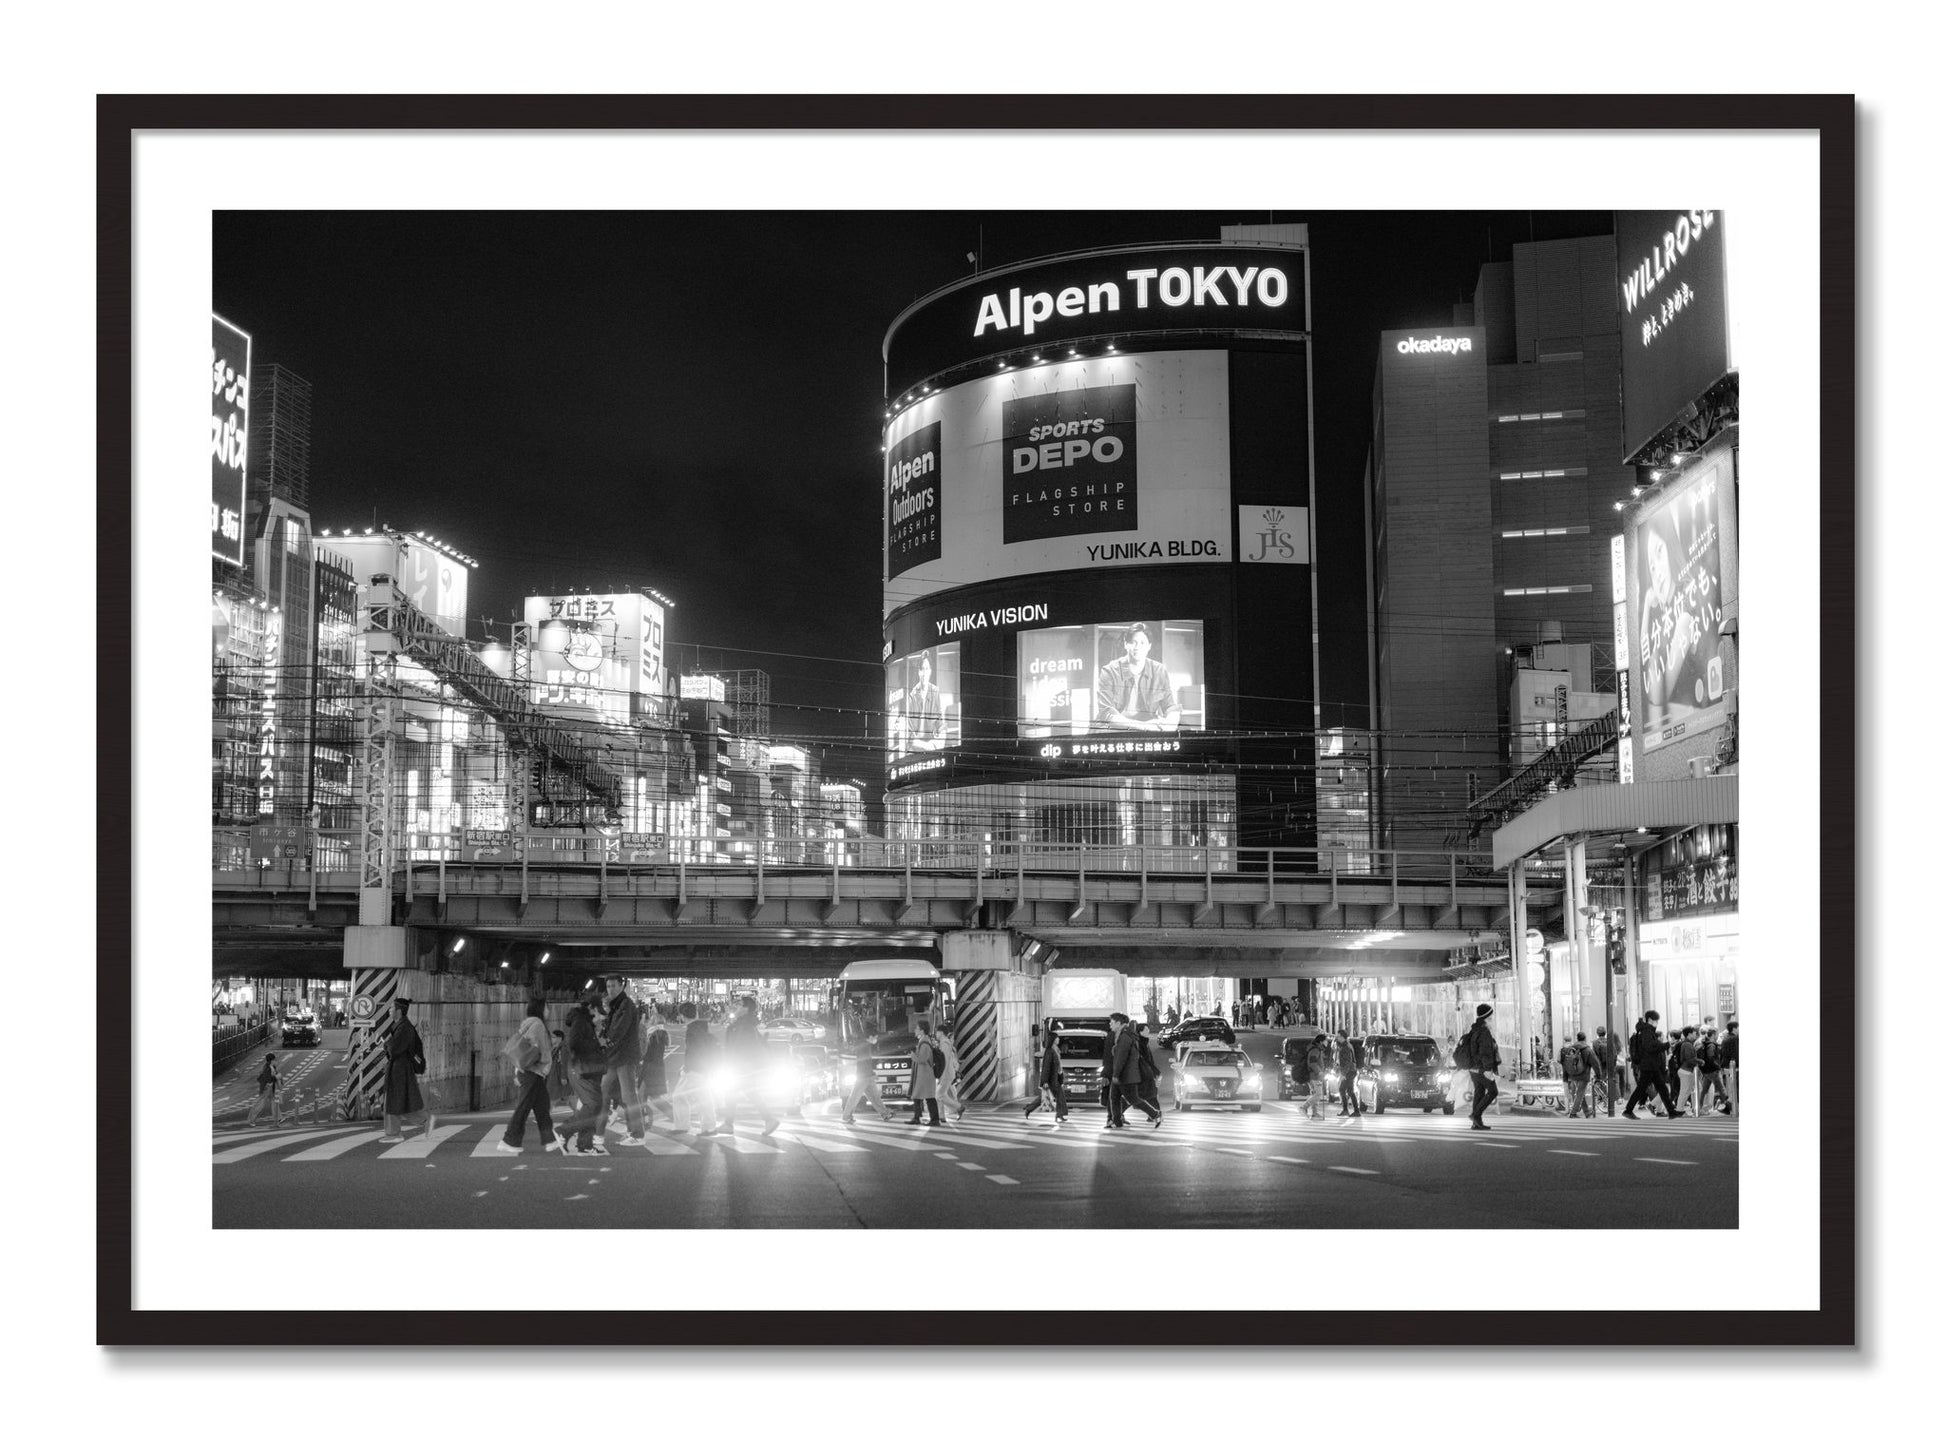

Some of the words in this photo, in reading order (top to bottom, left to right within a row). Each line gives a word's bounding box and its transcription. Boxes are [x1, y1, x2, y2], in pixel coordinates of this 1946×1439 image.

[973, 281, 1120, 337] Alpen
[1127, 266, 1288, 309] TOKYO
[1397, 335, 1472, 356] okadaya
[1029, 418, 1105, 442] SPORTS
[1013, 435, 1124, 474] DEPO
[890, 451, 935, 495] Alpen
[1013, 482, 1124, 505] FLAGSHIP
[893, 487, 934, 526] Outdoors
[1053, 499, 1124, 516] STORE
[889, 514, 935, 546] FLAGSHIP
[902, 530, 935, 553] STORE
[1087, 541, 1163, 562] YUNIKA
[1168, 540, 1222, 557] BLDG.
[324, 604, 352, 623] SHISHA
[549, 598, 616, 618] プロミス
[936, 611, 988, 636] YUNIKA
[990, 603, 1048, 626] VISION
[1641, 566, 1717, 666] 自分本位でも、
[1643, 603, 1722, 694] いいじゃない。
[1030, 657, 1083, 674] dream
[1040, 743, 1062, 759] dip
